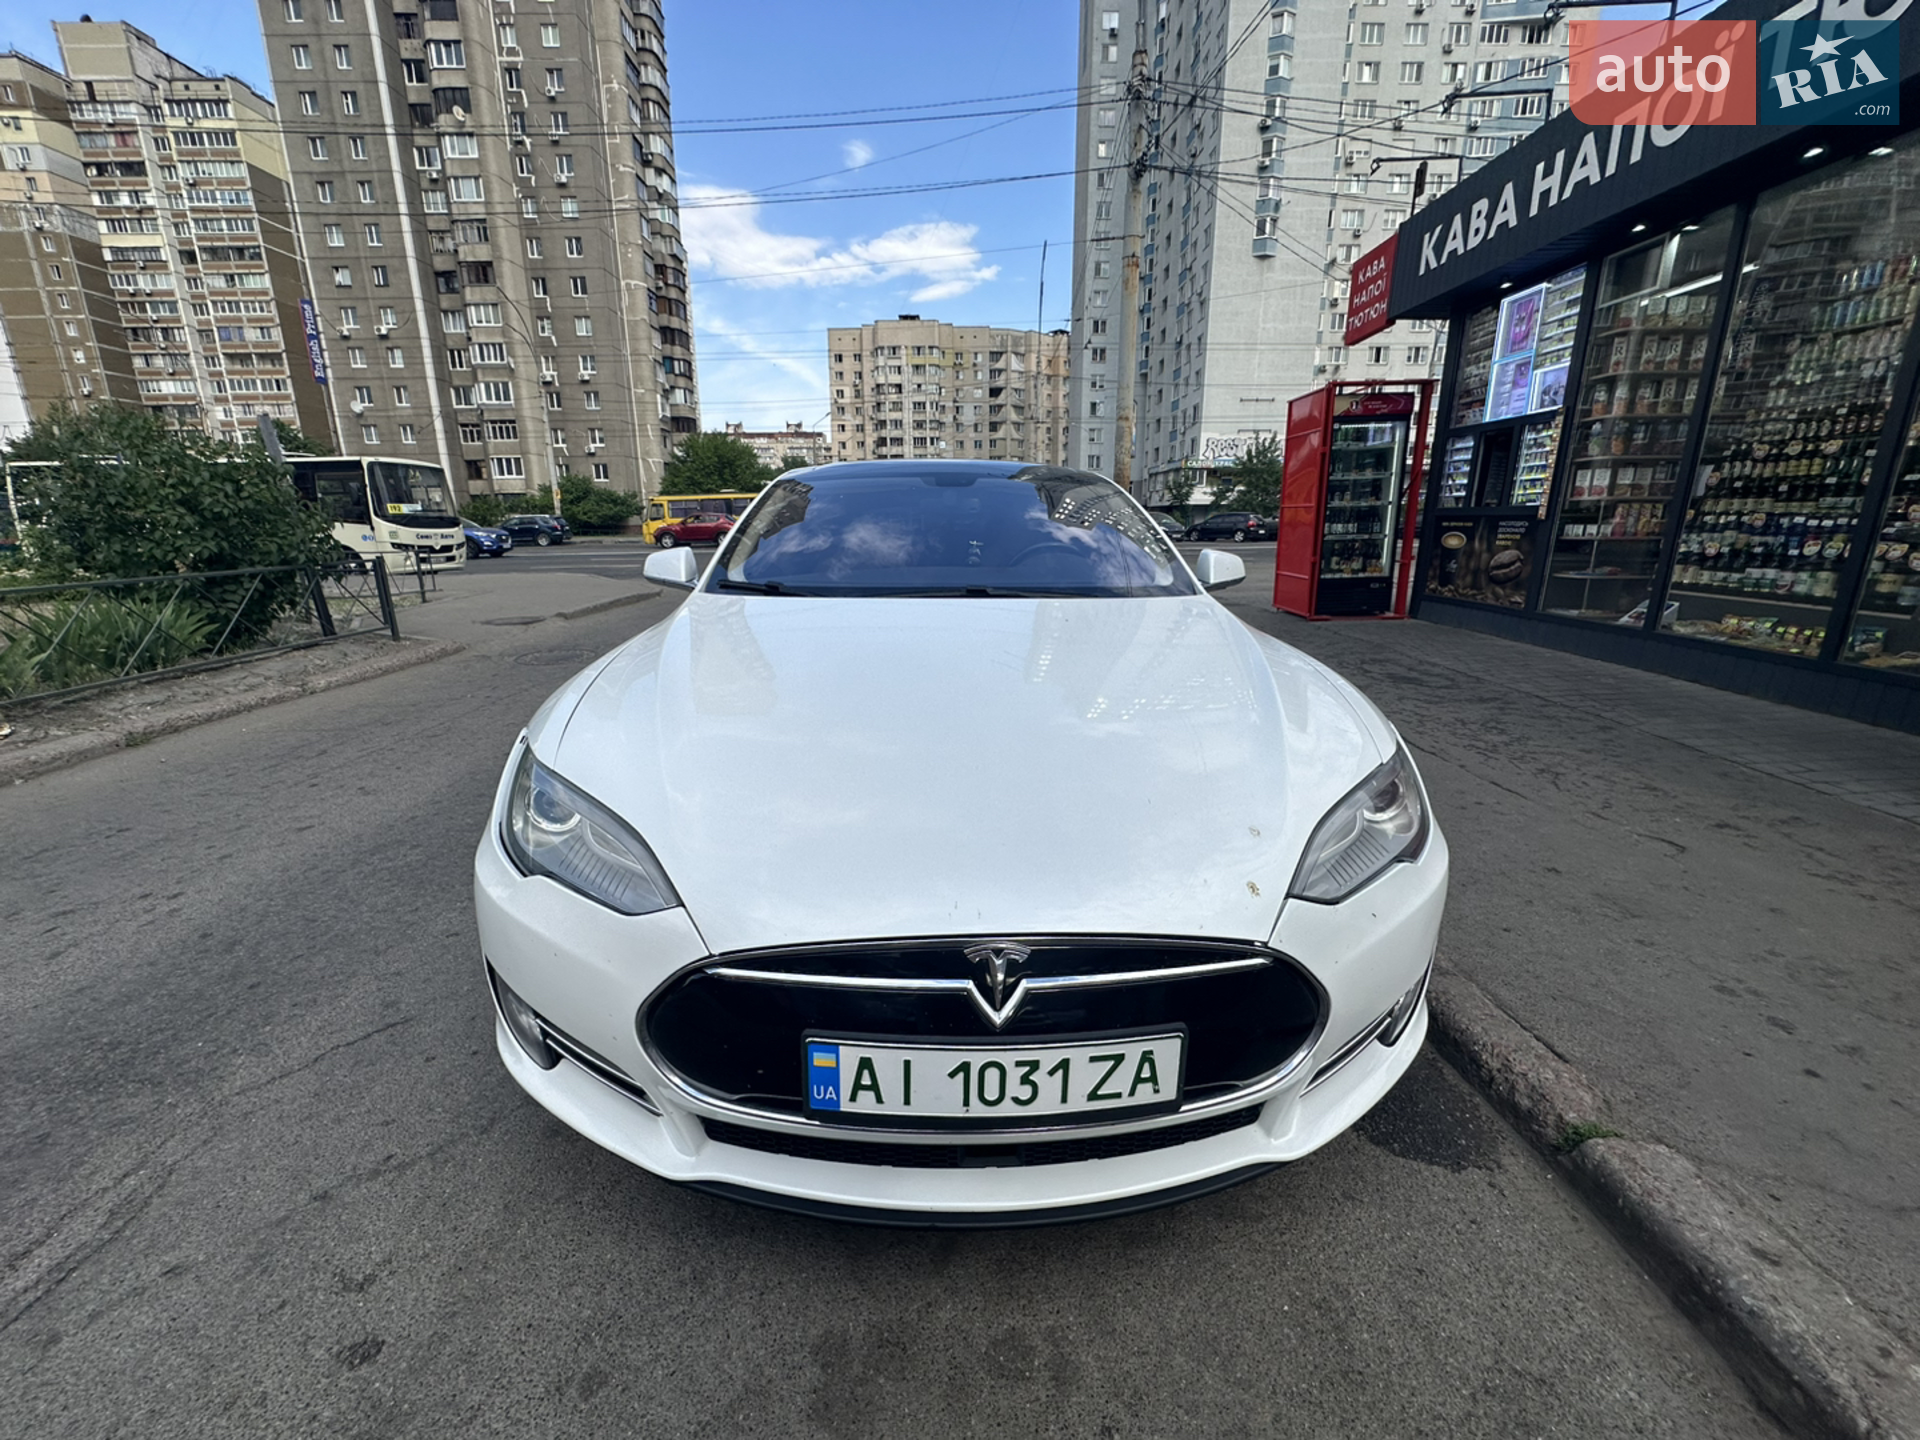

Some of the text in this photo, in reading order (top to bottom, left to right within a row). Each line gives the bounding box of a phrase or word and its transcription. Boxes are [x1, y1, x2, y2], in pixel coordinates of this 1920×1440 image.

[1419, 181, 1517, 276] КАВА
[1529, 20, 1746, 218] НАПОЇ
[1358, 255, 1386, 285] КАВА
[1353, 272, 1387, 308] НАПОЇ
[1348, 298, 1388, 331] ТЮТЮН
[303, 303, 325, 378] English Prime
[813, 1085, 837, 1101] UA
[848, 1050, 1160, 1108] AI 1031 ZA
